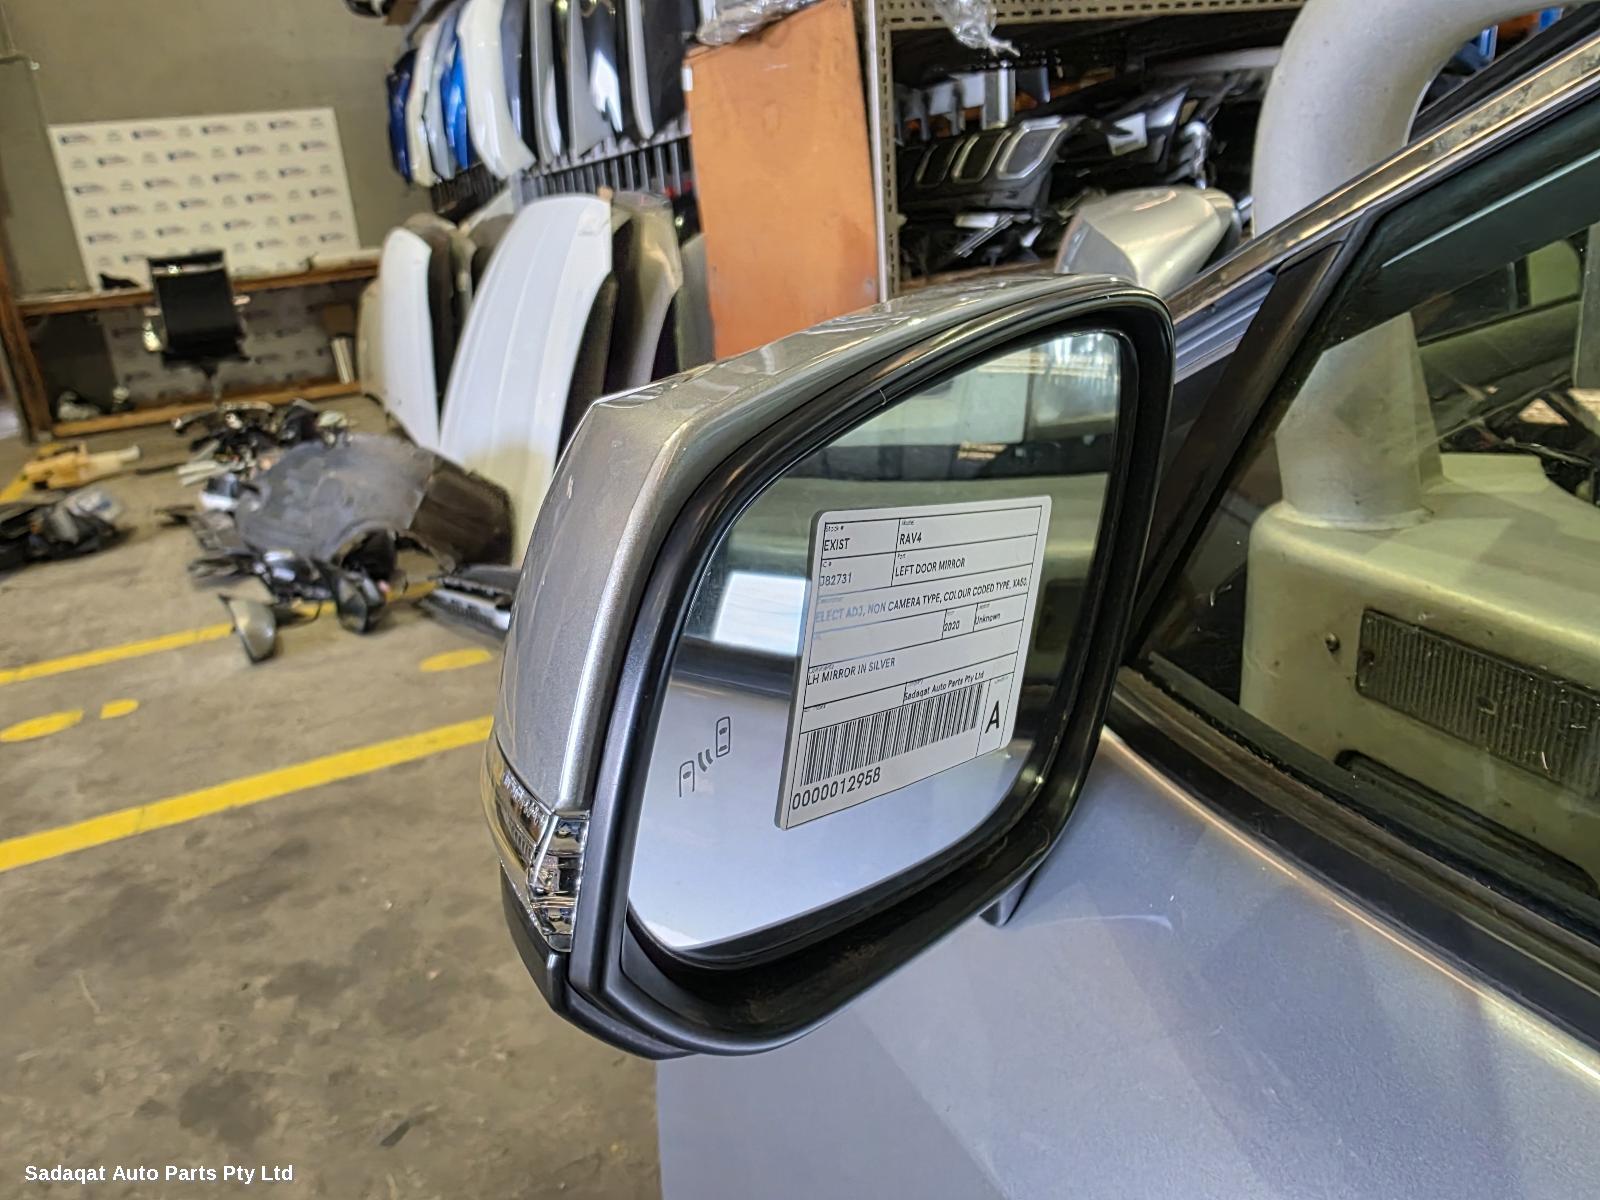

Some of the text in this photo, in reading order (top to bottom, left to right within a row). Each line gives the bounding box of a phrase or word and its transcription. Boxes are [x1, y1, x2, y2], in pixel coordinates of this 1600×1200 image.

[823, 537, 850, 551] EXIST
[899, 532, 922, 545] RAV4
[895, 557, 966, 577] LEFT DOOR MIRROR
[814, 609, 843, 622] ELECT
[867, 602, 887, 614] NON
[887, 596, 921, 612] CAMERA
[923, 592, 942, 605] TYPE,
[943, 588, 972, 602] COLOUR
[972, 583, 995, 597] CODED
[943, 620, 961, 632] 2020
[975, 612, 1001, 625] Unknown
[807, 674, 819, 686] LH
[821, 666, 856, 683] MIRROR
[857, 664, 867, 675] IN
[868, 657, 896, 672] SILVER
[903, 687, 930, 701] Sadaqat
[932, 682, 947, 693] Auto
[947, 677, 964, 688] Parts
[965, 674, 975, 683] Pty
[975, 671, 985, 679] Ltd
[984, 700, 1000, 734] A
[791, 766, 881, 810] 0000012958
